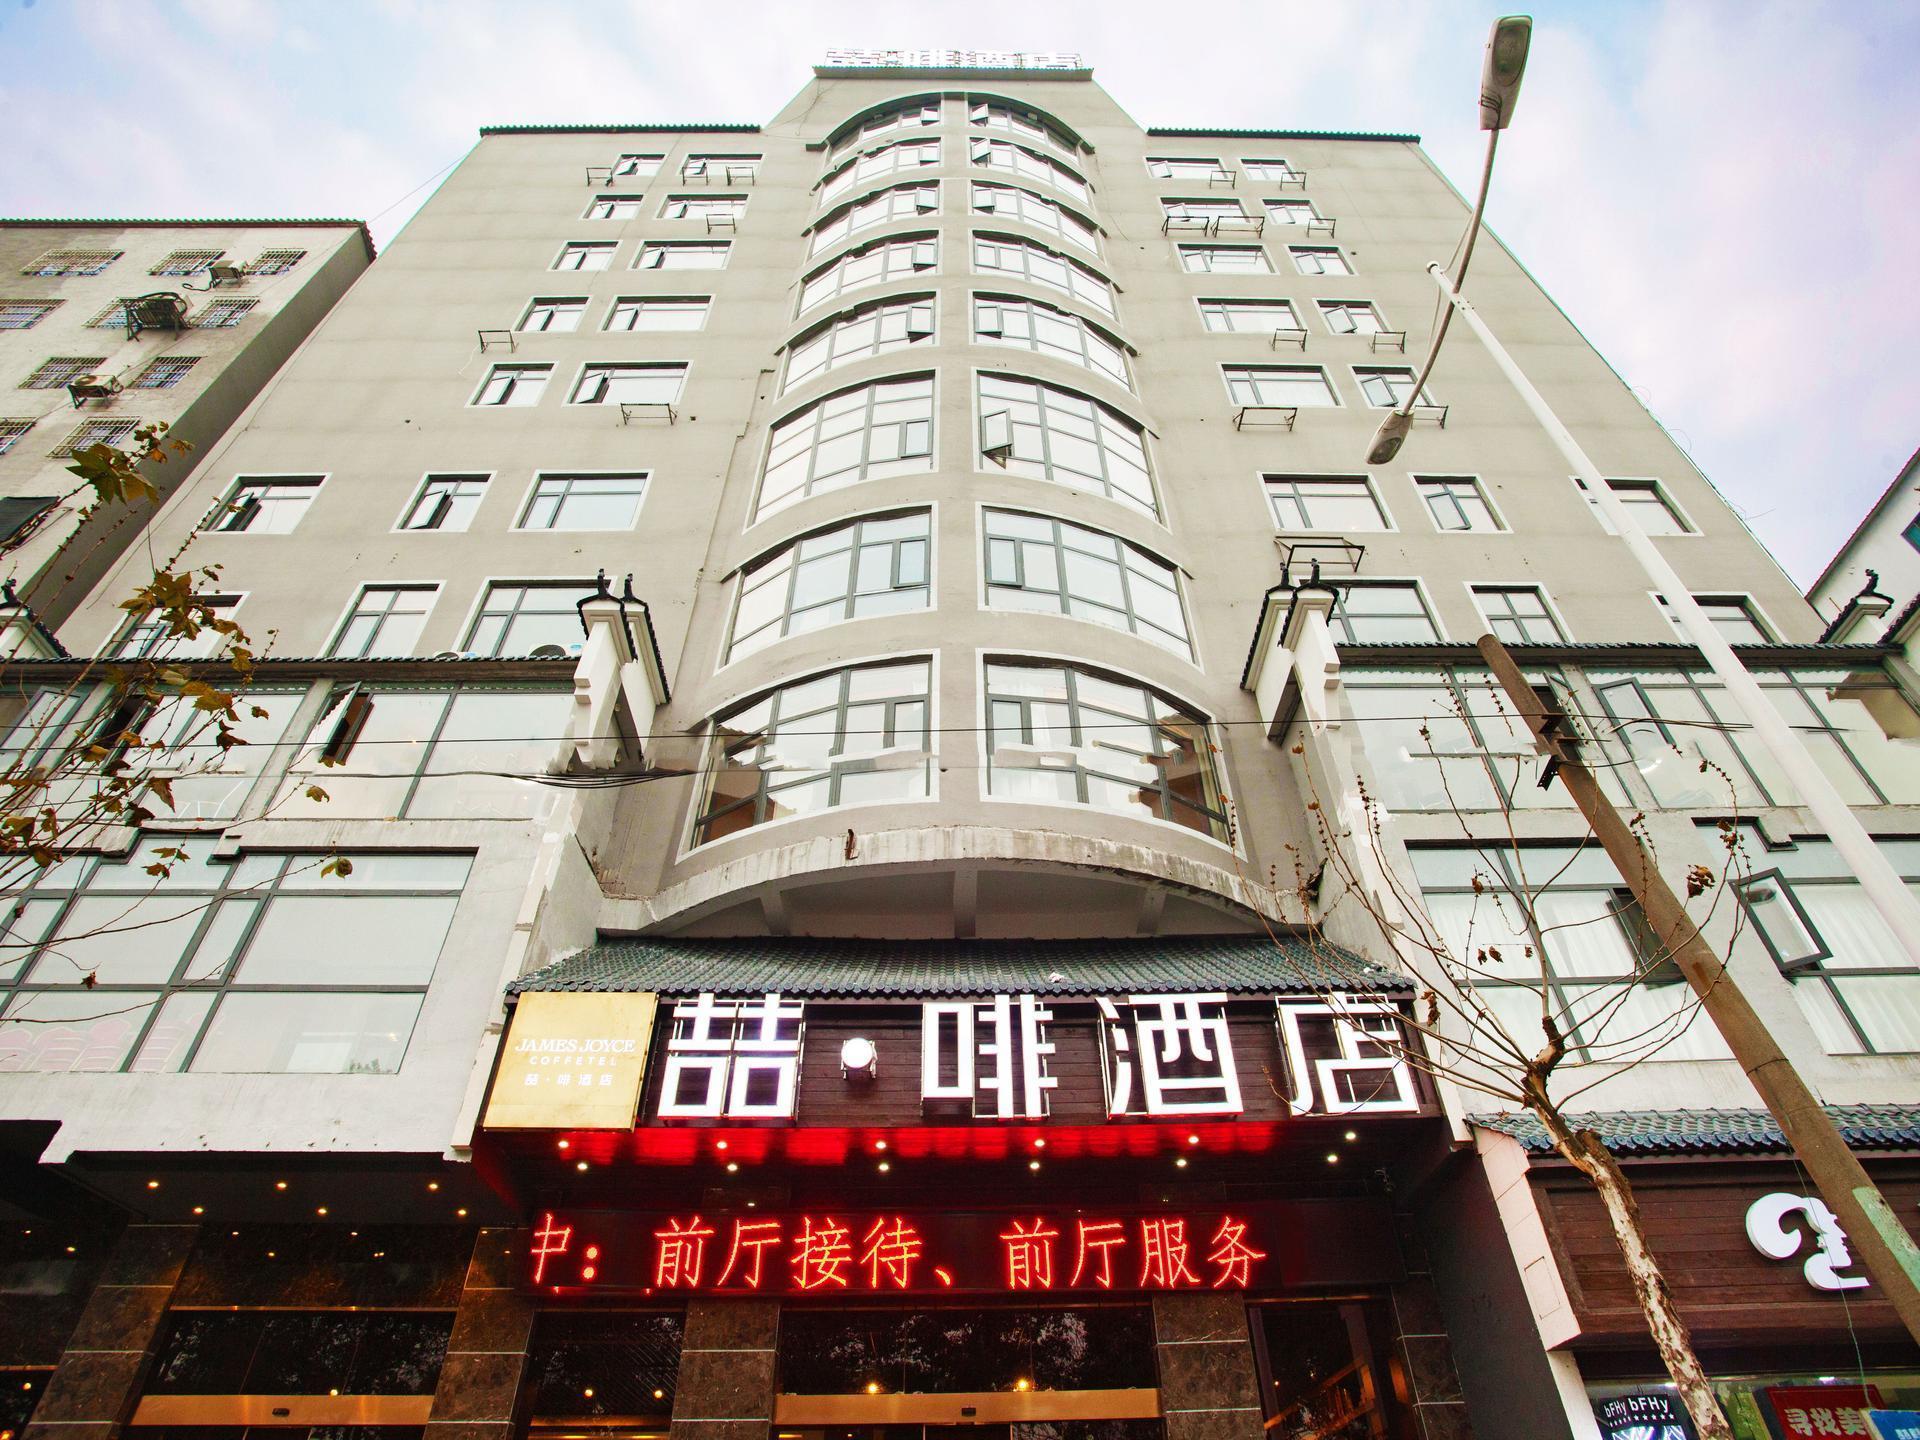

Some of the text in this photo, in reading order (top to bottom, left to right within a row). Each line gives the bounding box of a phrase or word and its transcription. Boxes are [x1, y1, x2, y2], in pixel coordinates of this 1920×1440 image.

[515, 1038, 635, 1053] JAMES JOYCE
[529, 1056, 617, 1067] COFFETEL
